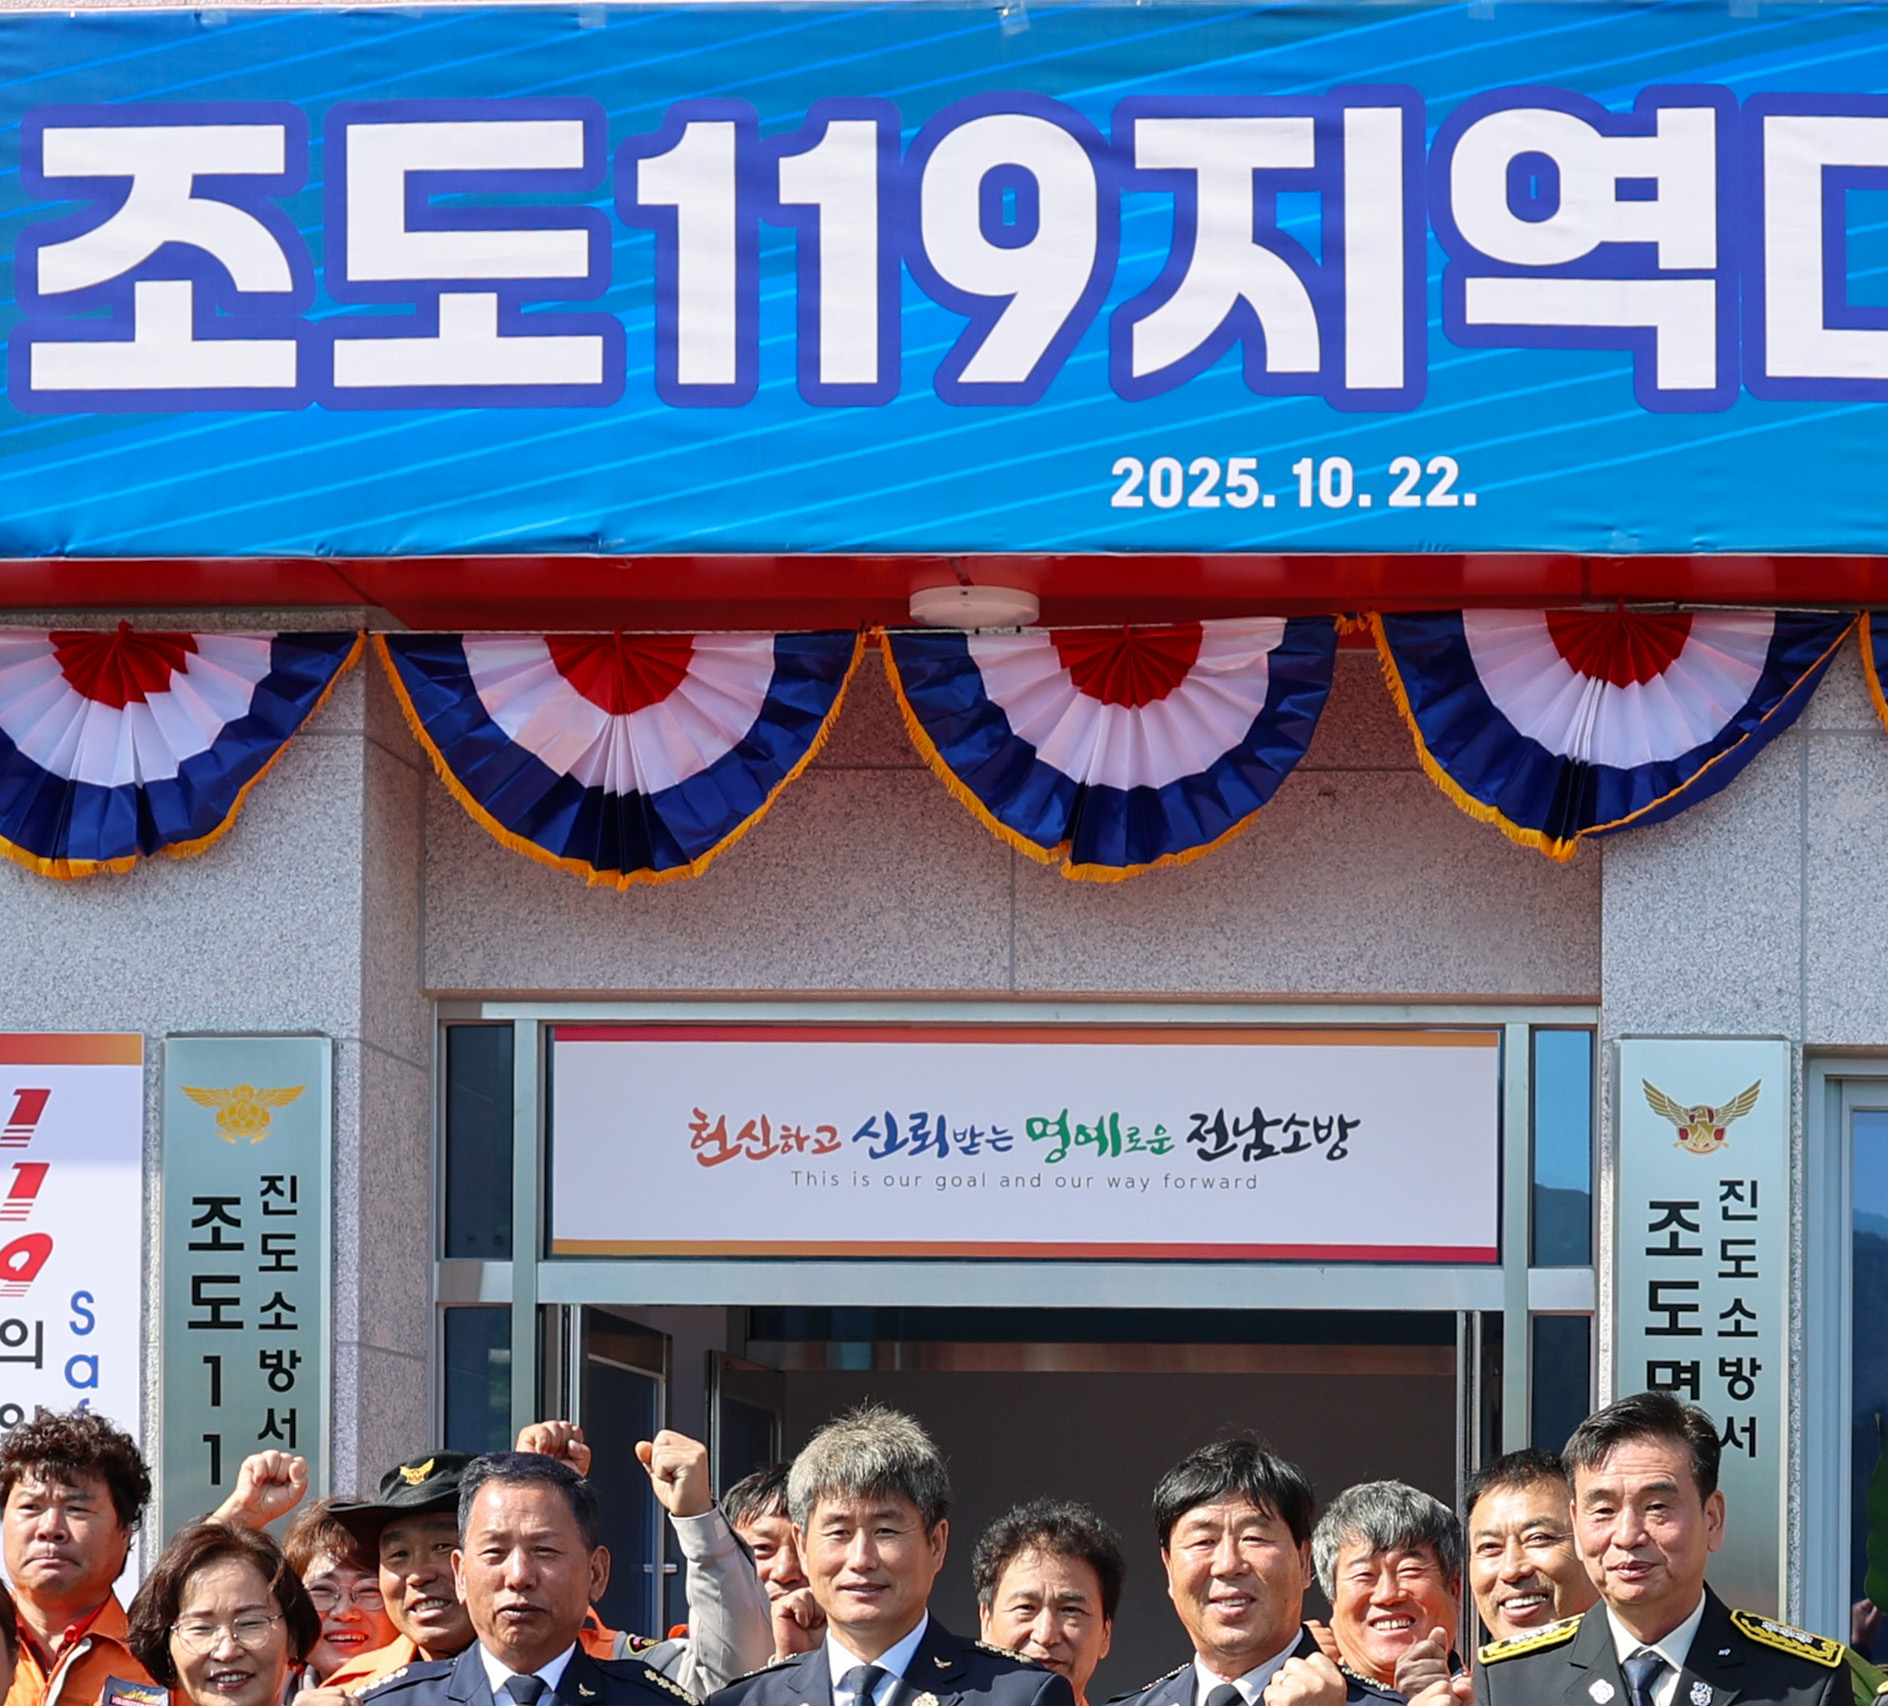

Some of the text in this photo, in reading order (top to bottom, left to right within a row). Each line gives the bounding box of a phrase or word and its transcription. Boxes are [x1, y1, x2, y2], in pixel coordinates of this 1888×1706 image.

[1110, 455, 1478, 509] 2025. 10. 22.
[687, 1105, 1362, 1168] 헌신하고 신뢰받는 명예로운 전남소방
[791, 1171, 1258, 1193] This is our goal and our way forward
[257, 1174, 302, 1450] 진도소방서
[1717, 1179, 1762, 1459] 진도소방서
